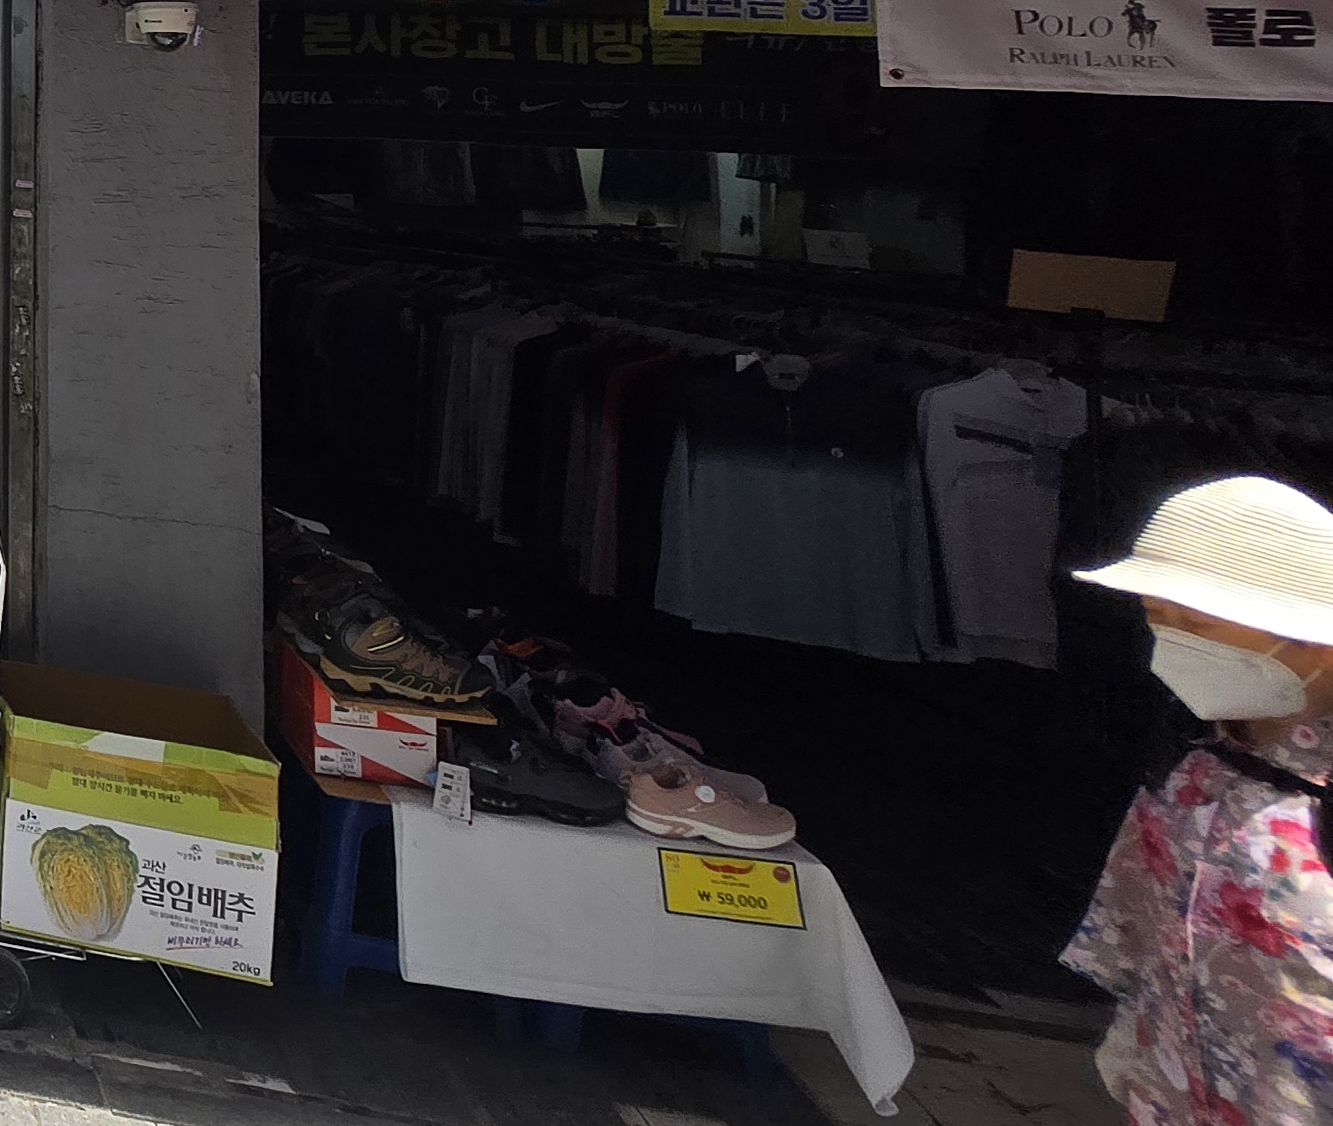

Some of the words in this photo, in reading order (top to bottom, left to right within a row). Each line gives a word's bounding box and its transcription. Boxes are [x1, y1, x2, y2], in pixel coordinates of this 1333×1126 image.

[300, 12, 517, 62] 본사창고
[1011, 7, 1114, 40] POLO
[1204, 6, 1318, 47] 폴로
[1008, 46, 1081, 67] RALPH
[1085, 49, 1178, 69] LAUREN
[141, 859, 167, 875] 괴산
[136, 873, 257, 923] 절임배추
[231, 959, 262, 977] 20kg
